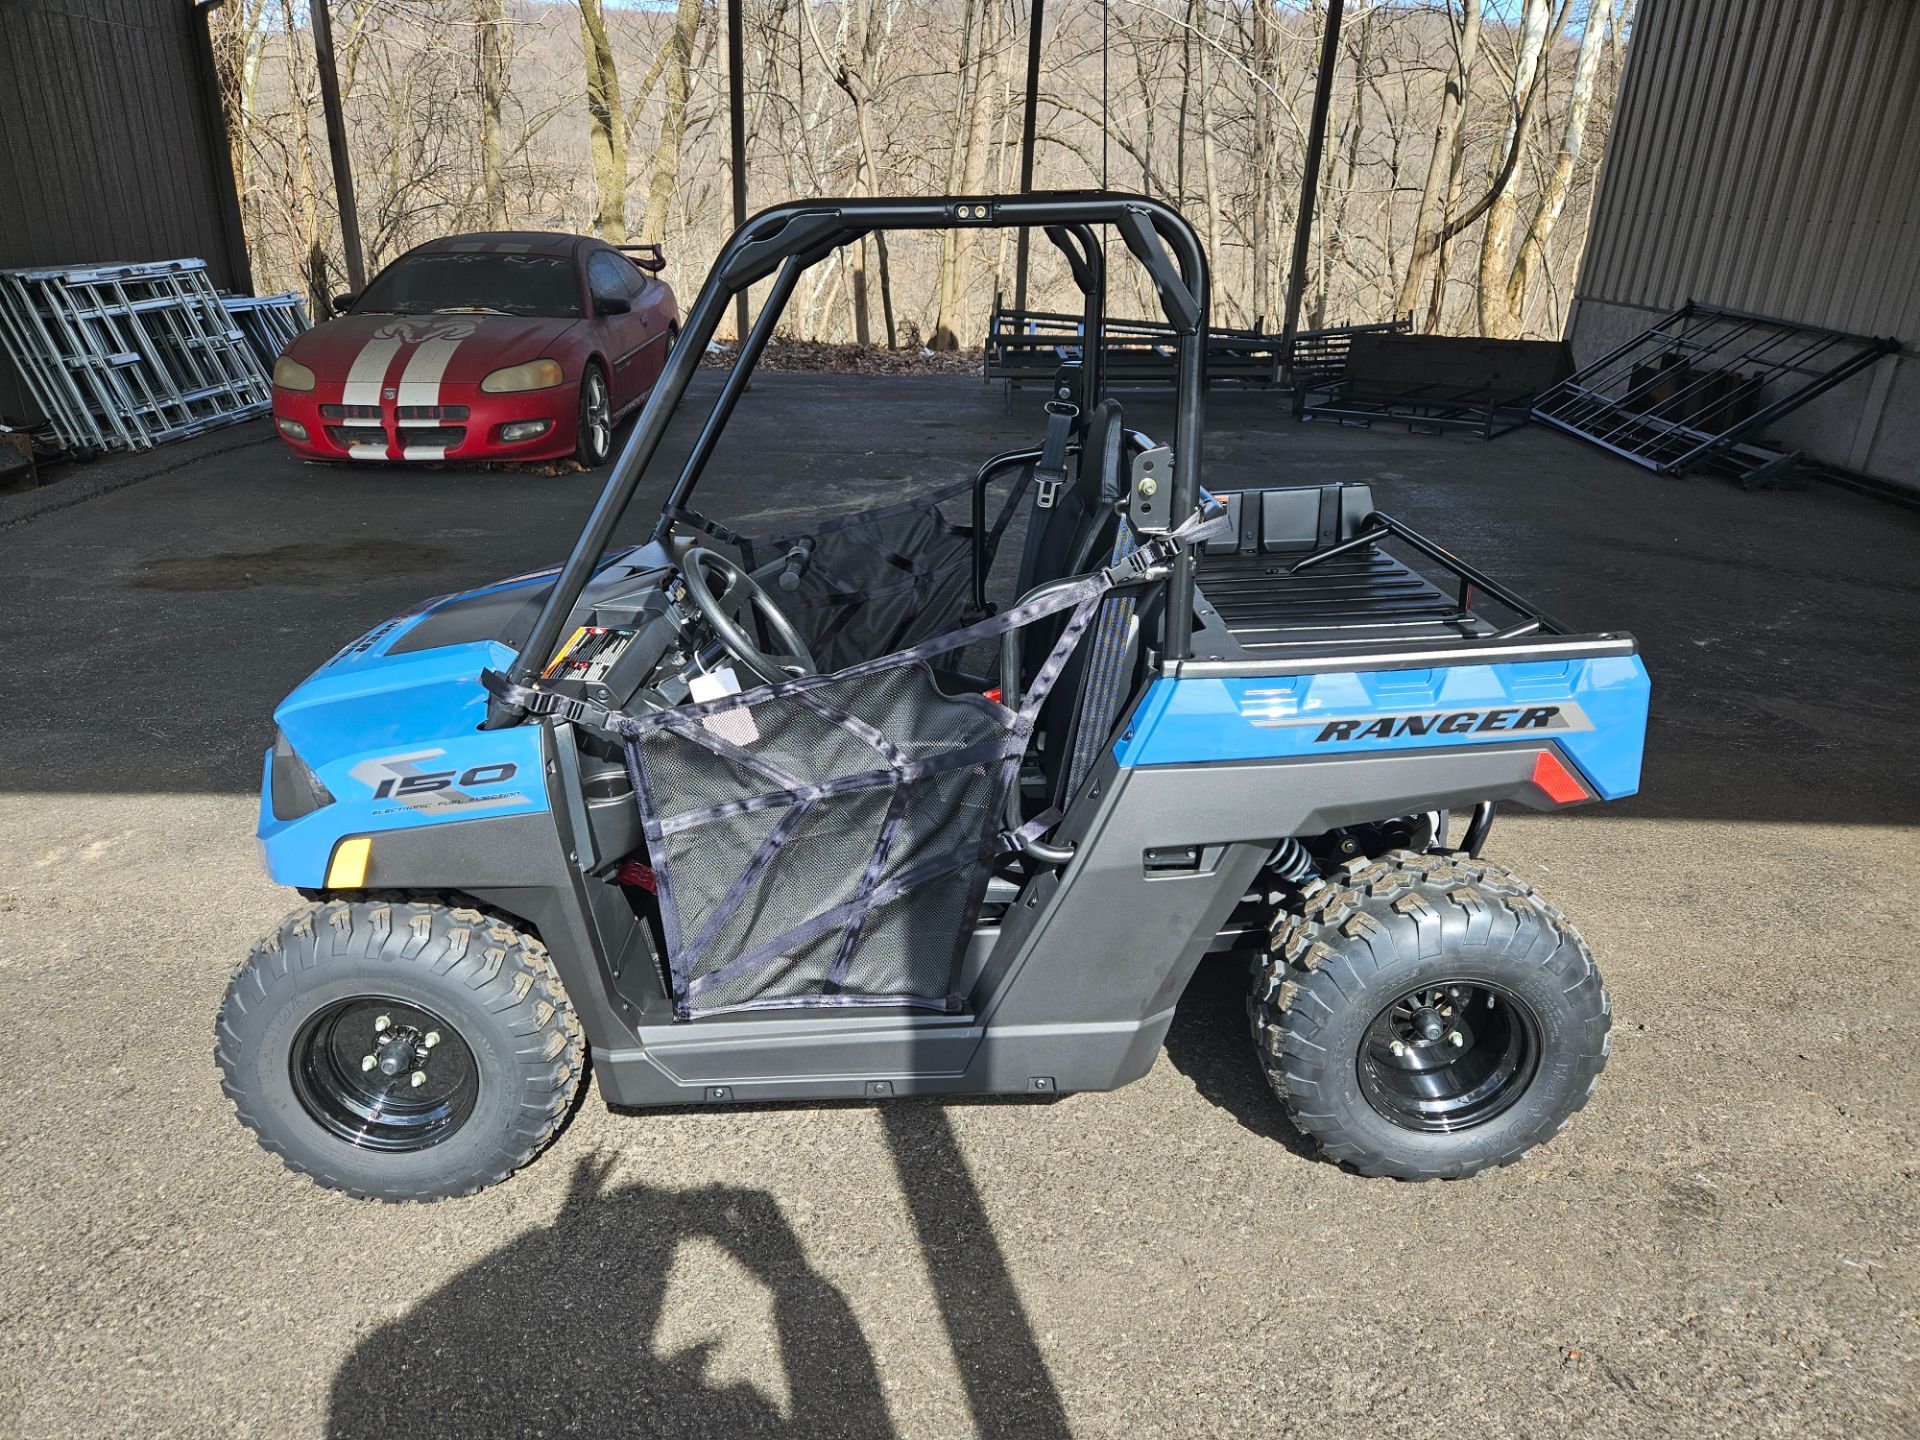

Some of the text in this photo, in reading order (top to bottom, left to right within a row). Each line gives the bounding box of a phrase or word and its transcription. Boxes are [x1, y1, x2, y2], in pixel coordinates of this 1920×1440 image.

[1312, 705, 1561, 743] RANGER
[372, 762, 517, 800] 150
[372, 791, 520, 815] ELECTRONIC FUEL INJECTION
